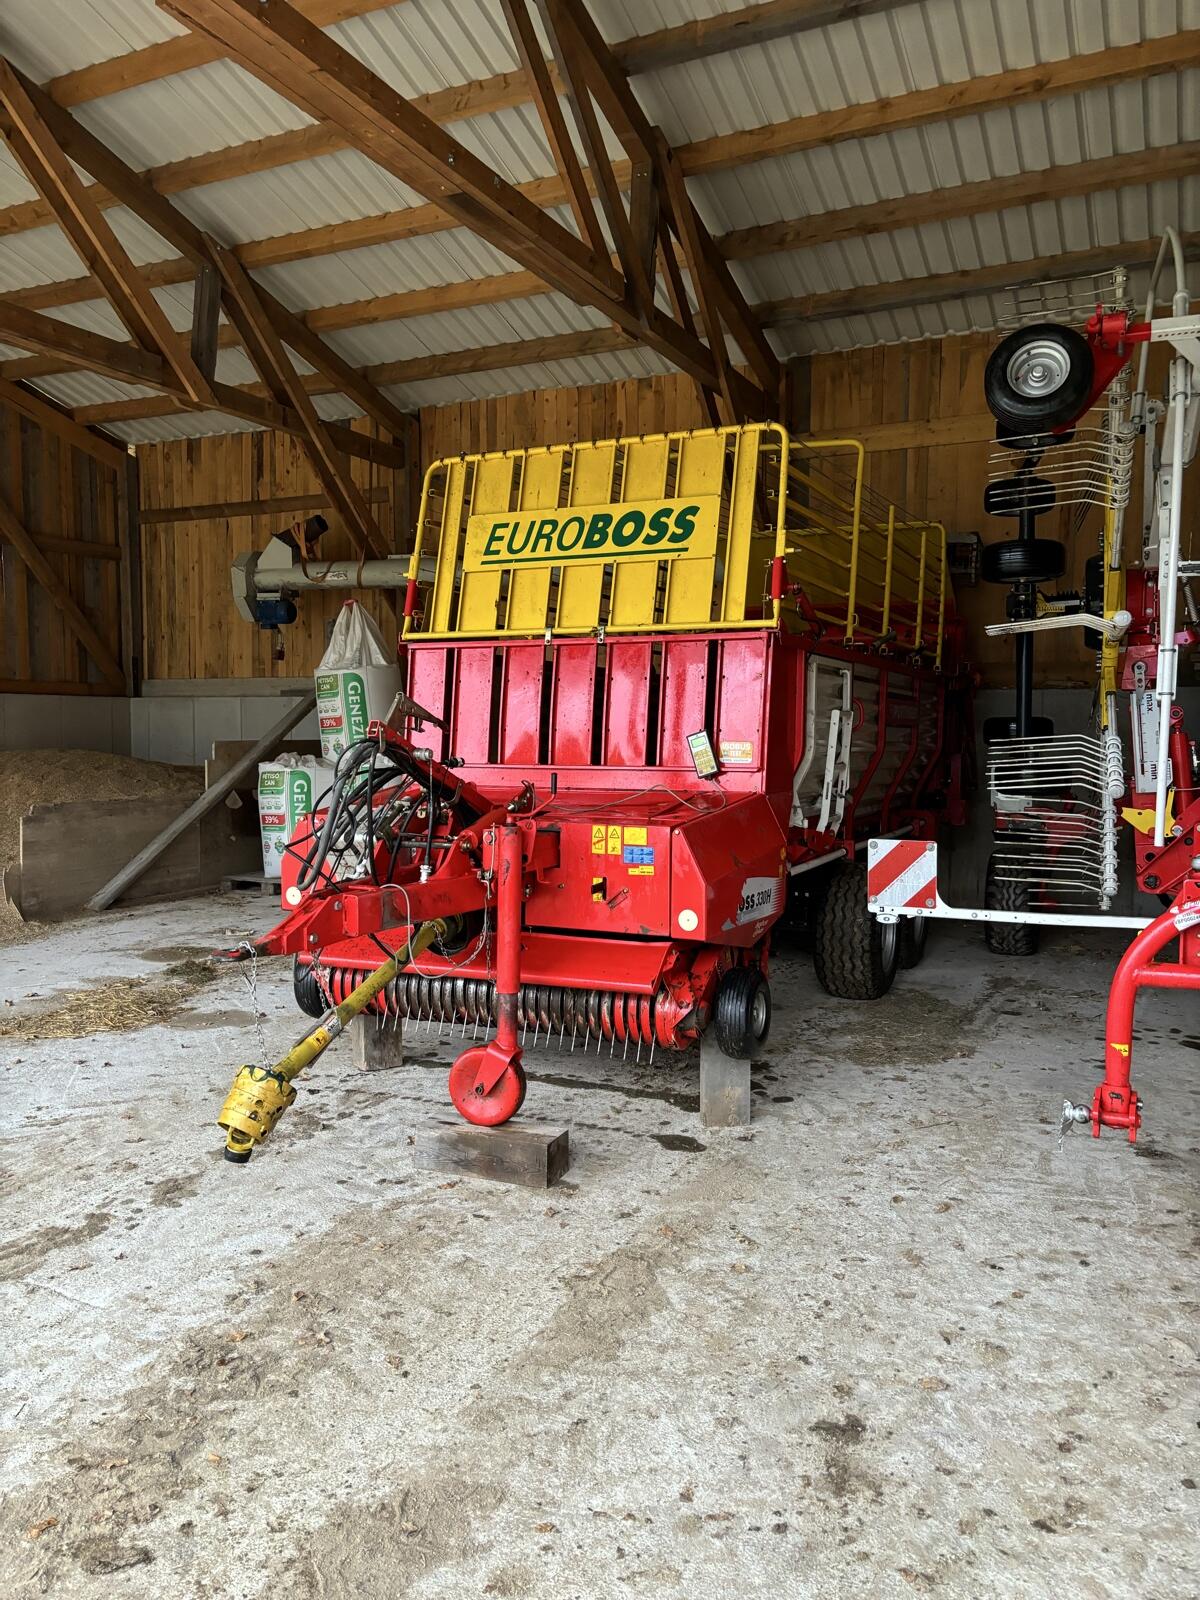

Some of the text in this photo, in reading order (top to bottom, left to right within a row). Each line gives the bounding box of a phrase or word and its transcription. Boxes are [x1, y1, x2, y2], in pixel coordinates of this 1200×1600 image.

[483, 505, 701, 556] EUROBOSS
[322, 718, 337, 727] 39%
[347, 681, 365, 742] GENEZI
[264, 815, 279, 824] 39%
[738, 888, 772, 912] OSS 330H
